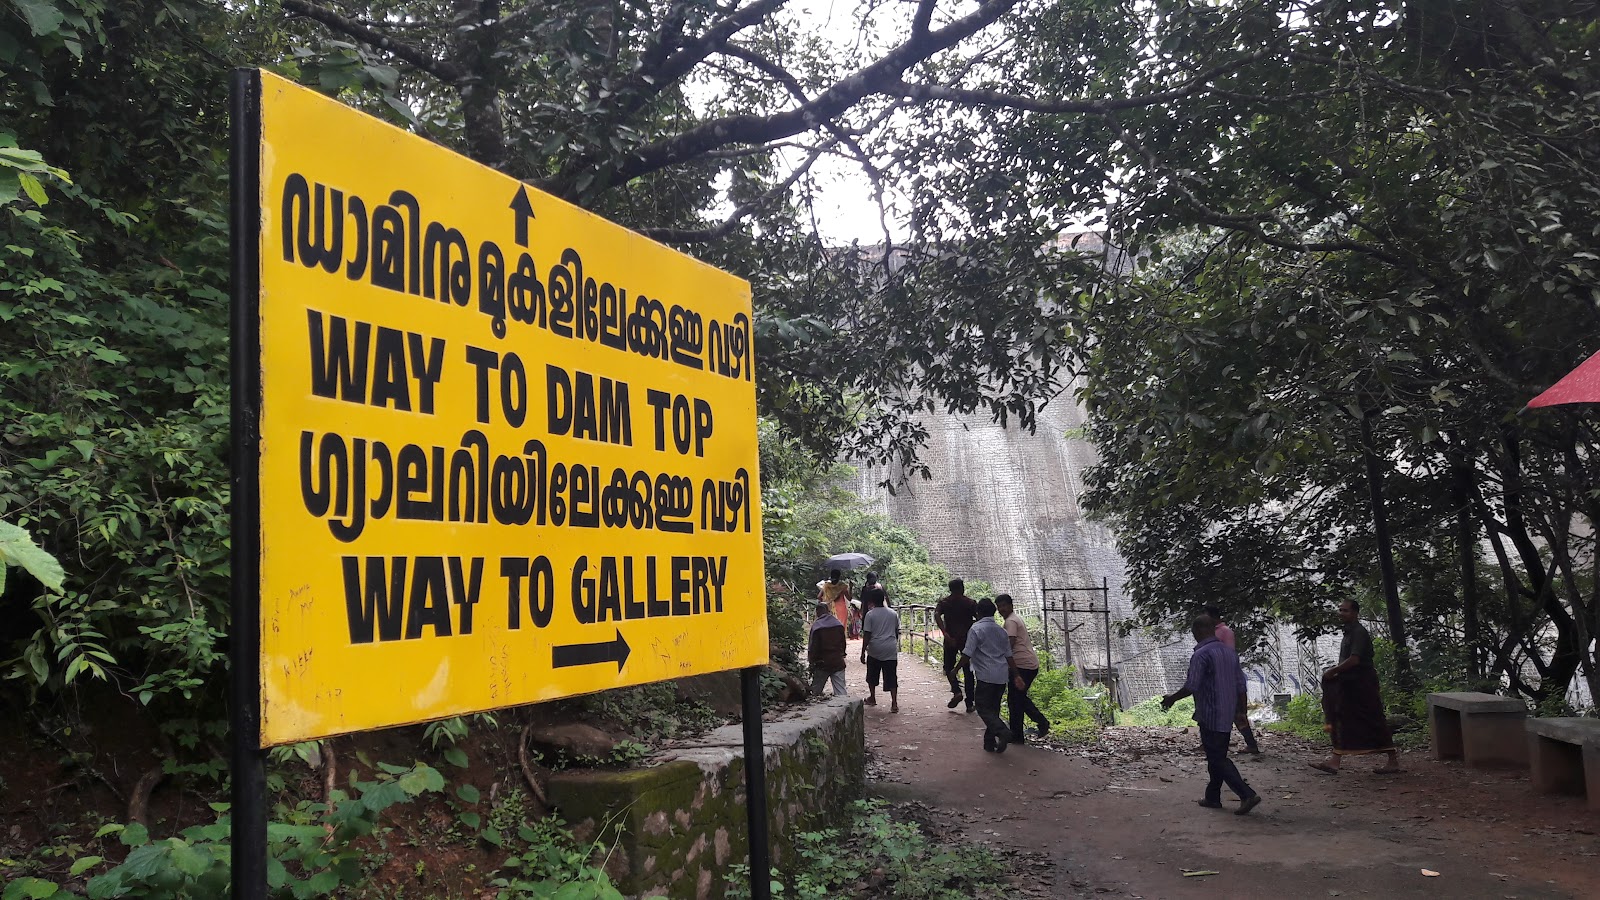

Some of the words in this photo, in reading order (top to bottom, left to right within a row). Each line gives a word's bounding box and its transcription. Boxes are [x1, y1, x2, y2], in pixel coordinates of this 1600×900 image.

[281, 172, 472, 307] ഡാമിനു
[708, 312, 751, 382] വഴി
[306, 308, 446, 415] WAY
[465, 344, 527, 429] TO
[545, 363, 633, 447] DAM
[646, 388, 713, 458] TOP
[700, 467, 751, 533] വഴി
[341, 556, 485, 645] WAY
[500, 556, 555, 630] TO
[571, 555, 728, 625] GALLERY
